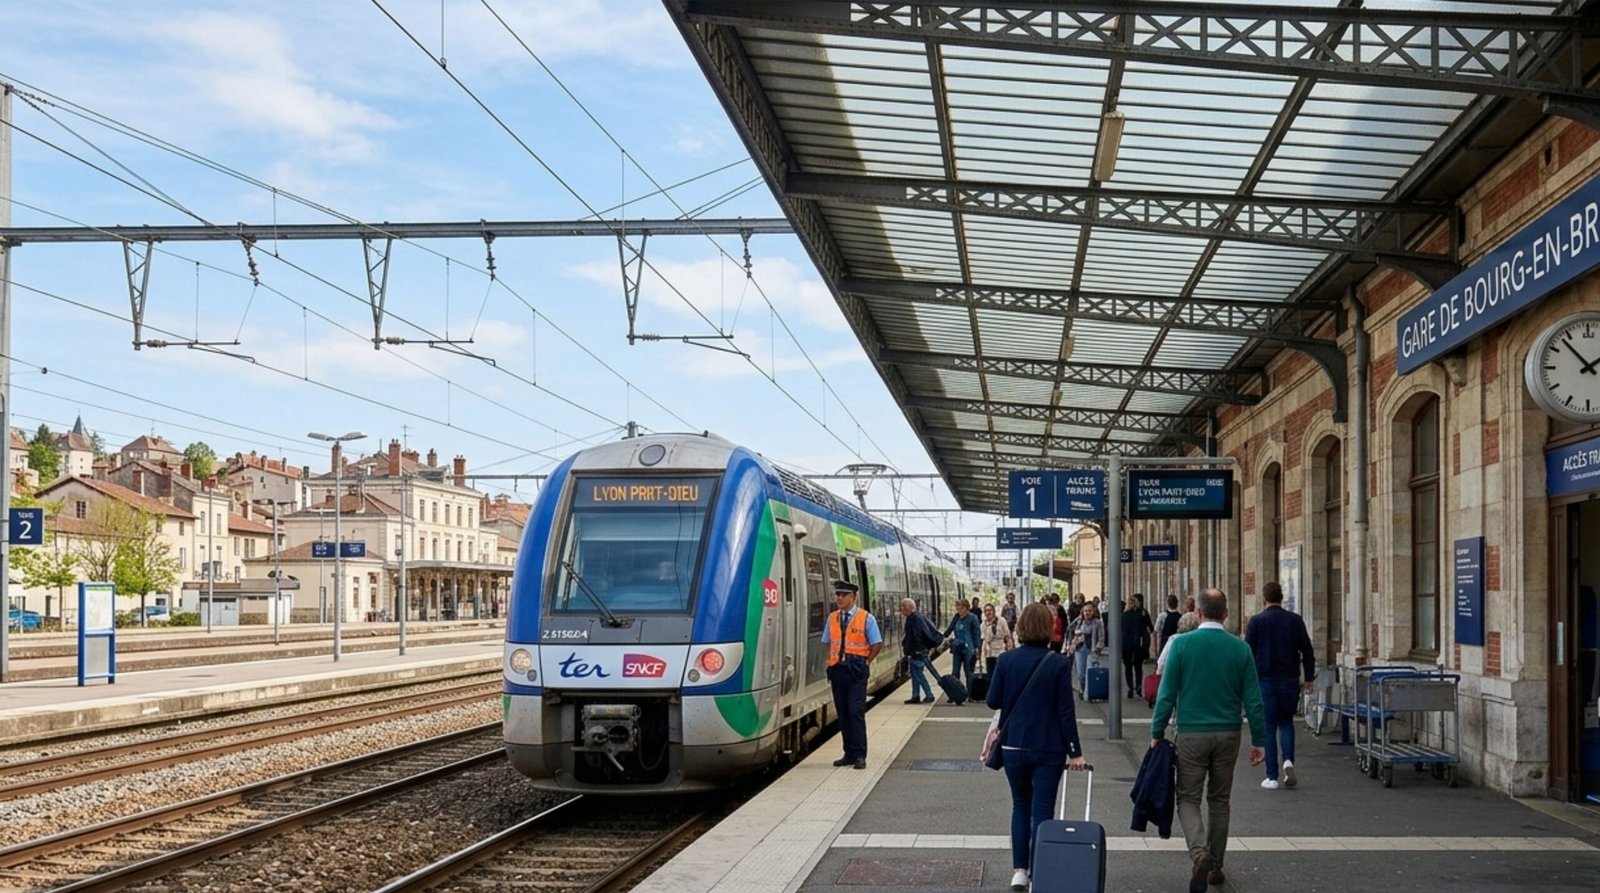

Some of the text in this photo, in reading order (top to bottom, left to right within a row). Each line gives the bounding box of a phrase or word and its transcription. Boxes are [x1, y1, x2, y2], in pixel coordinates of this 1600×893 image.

[1402, 202, 1600, 358] GARE DE BOURG-EN-BR
[593, 485, 627, 501] LYON
[1025, 487, 1036, 512] 1
[20, 520, 32, 539] 2
[558, 652, 611, 678] ter
[625, 662, 664, 675] SNCF
